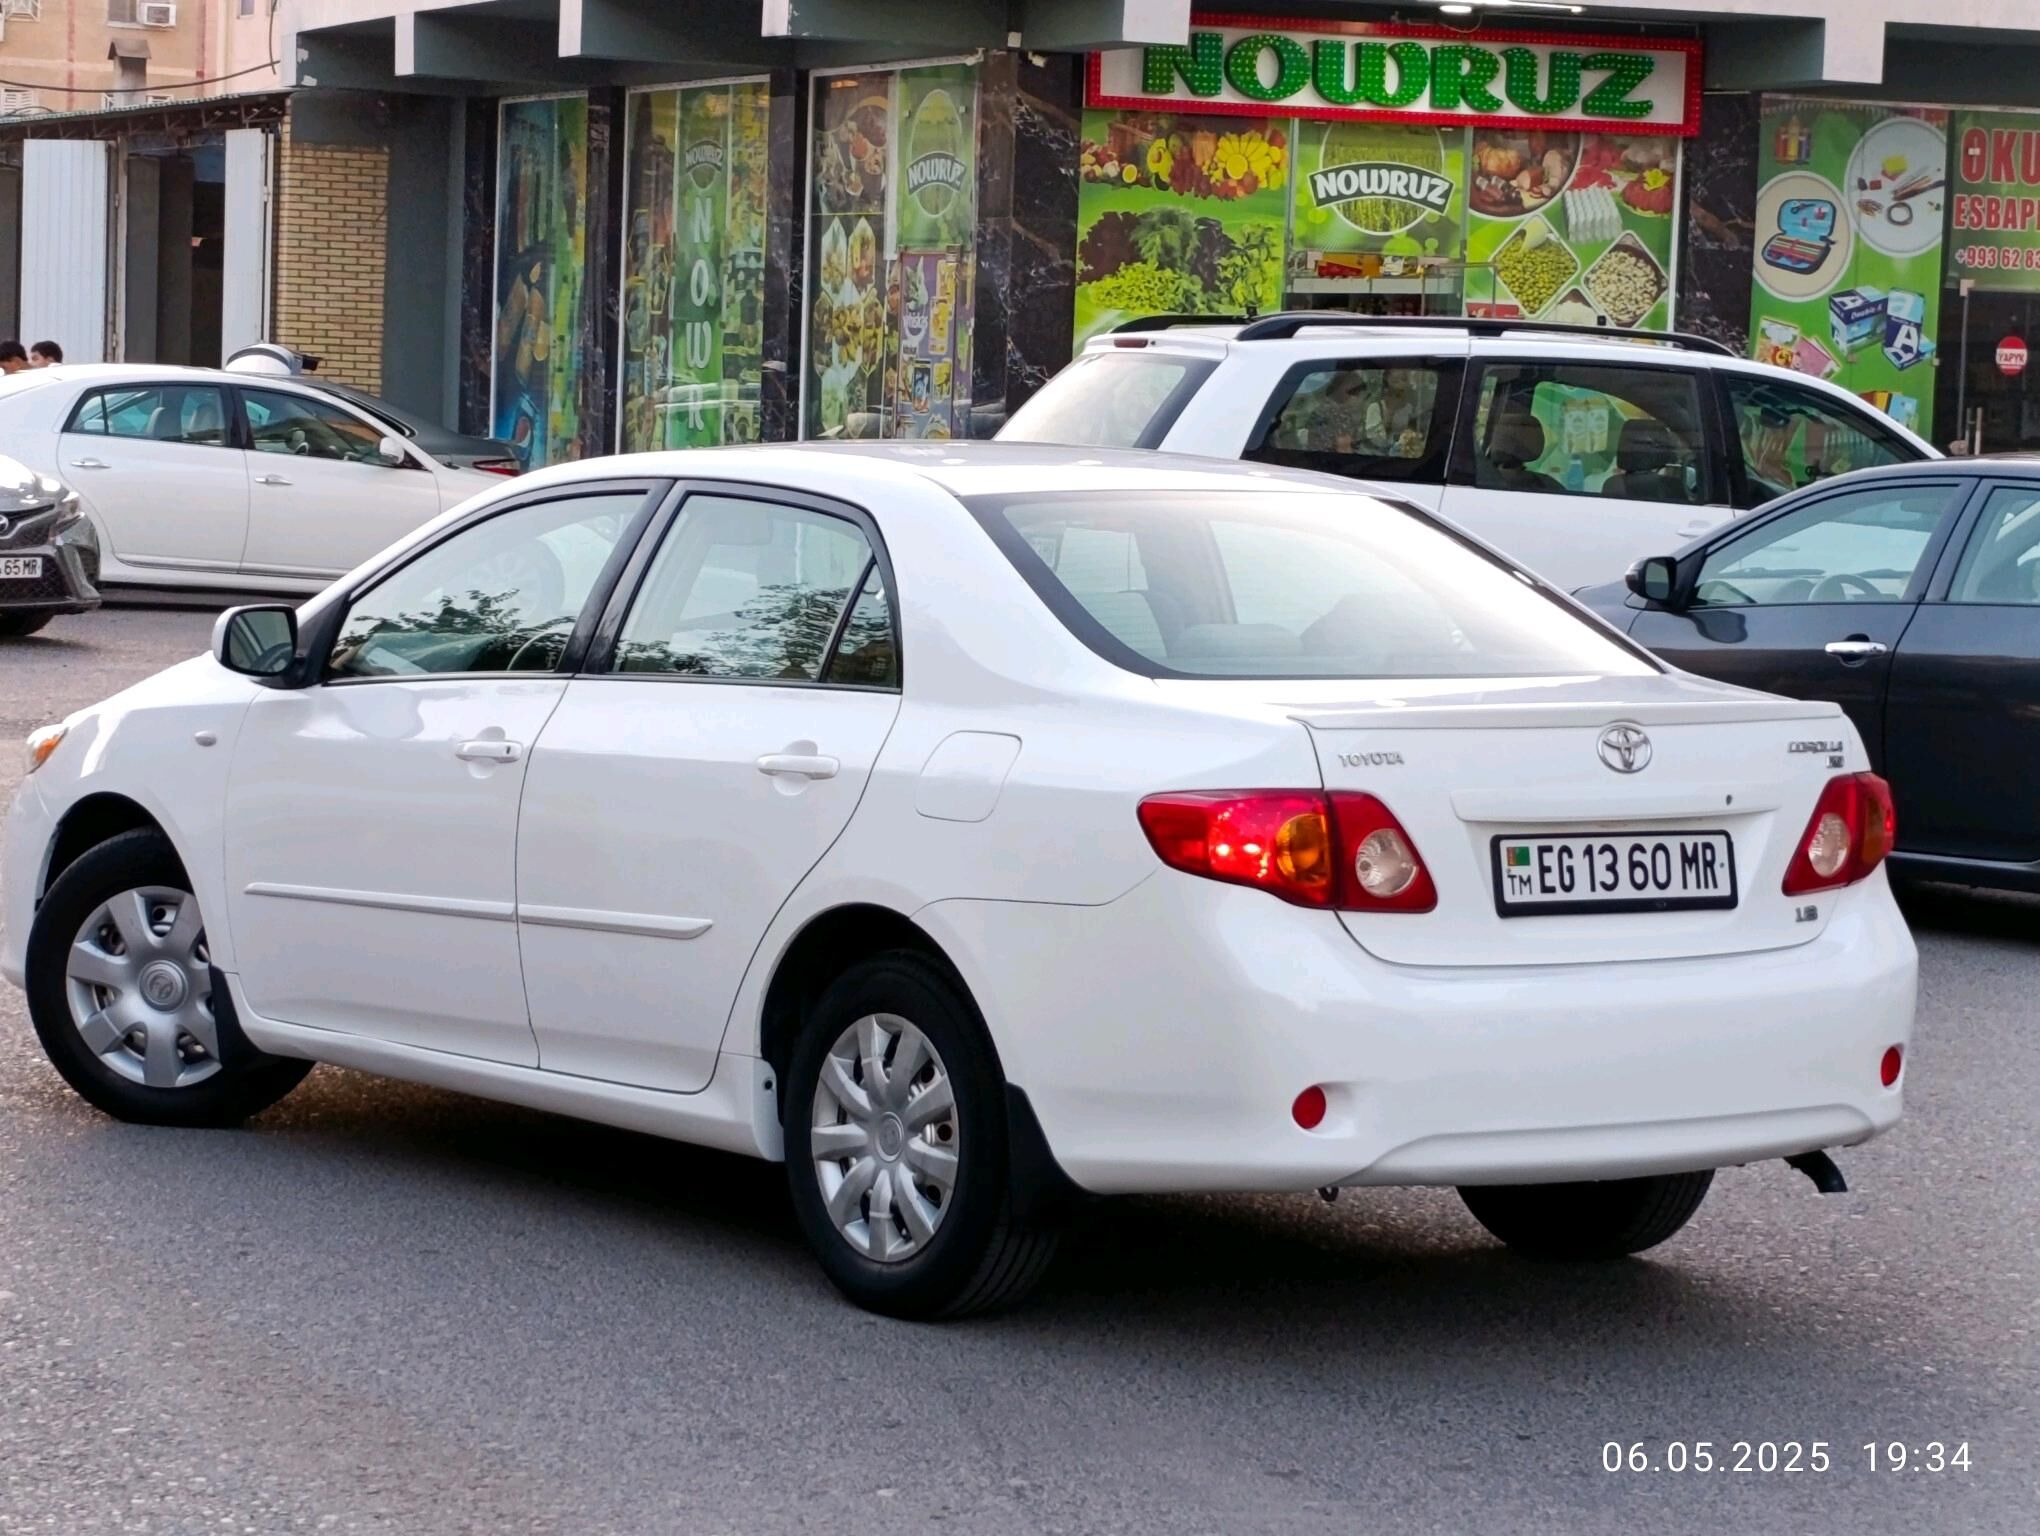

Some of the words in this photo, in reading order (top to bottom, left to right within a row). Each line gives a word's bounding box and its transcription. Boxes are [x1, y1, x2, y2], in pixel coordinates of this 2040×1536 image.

[1141, 32, 1656, 118] NOWRUZ
[908, 158, 965, 189] NOWRUZ
[1315, 167, 1449, 206] NOWRUZ
[1955, 246, 1998, 269] +993
[2001, 249, 2021, 269] 62
[4, 559, 21, 576] 65
[22, 559, 38, 576] MR
[1338, 752, 1405, 768] TOYOTA
[1507, 874, 1532, 895] TM
